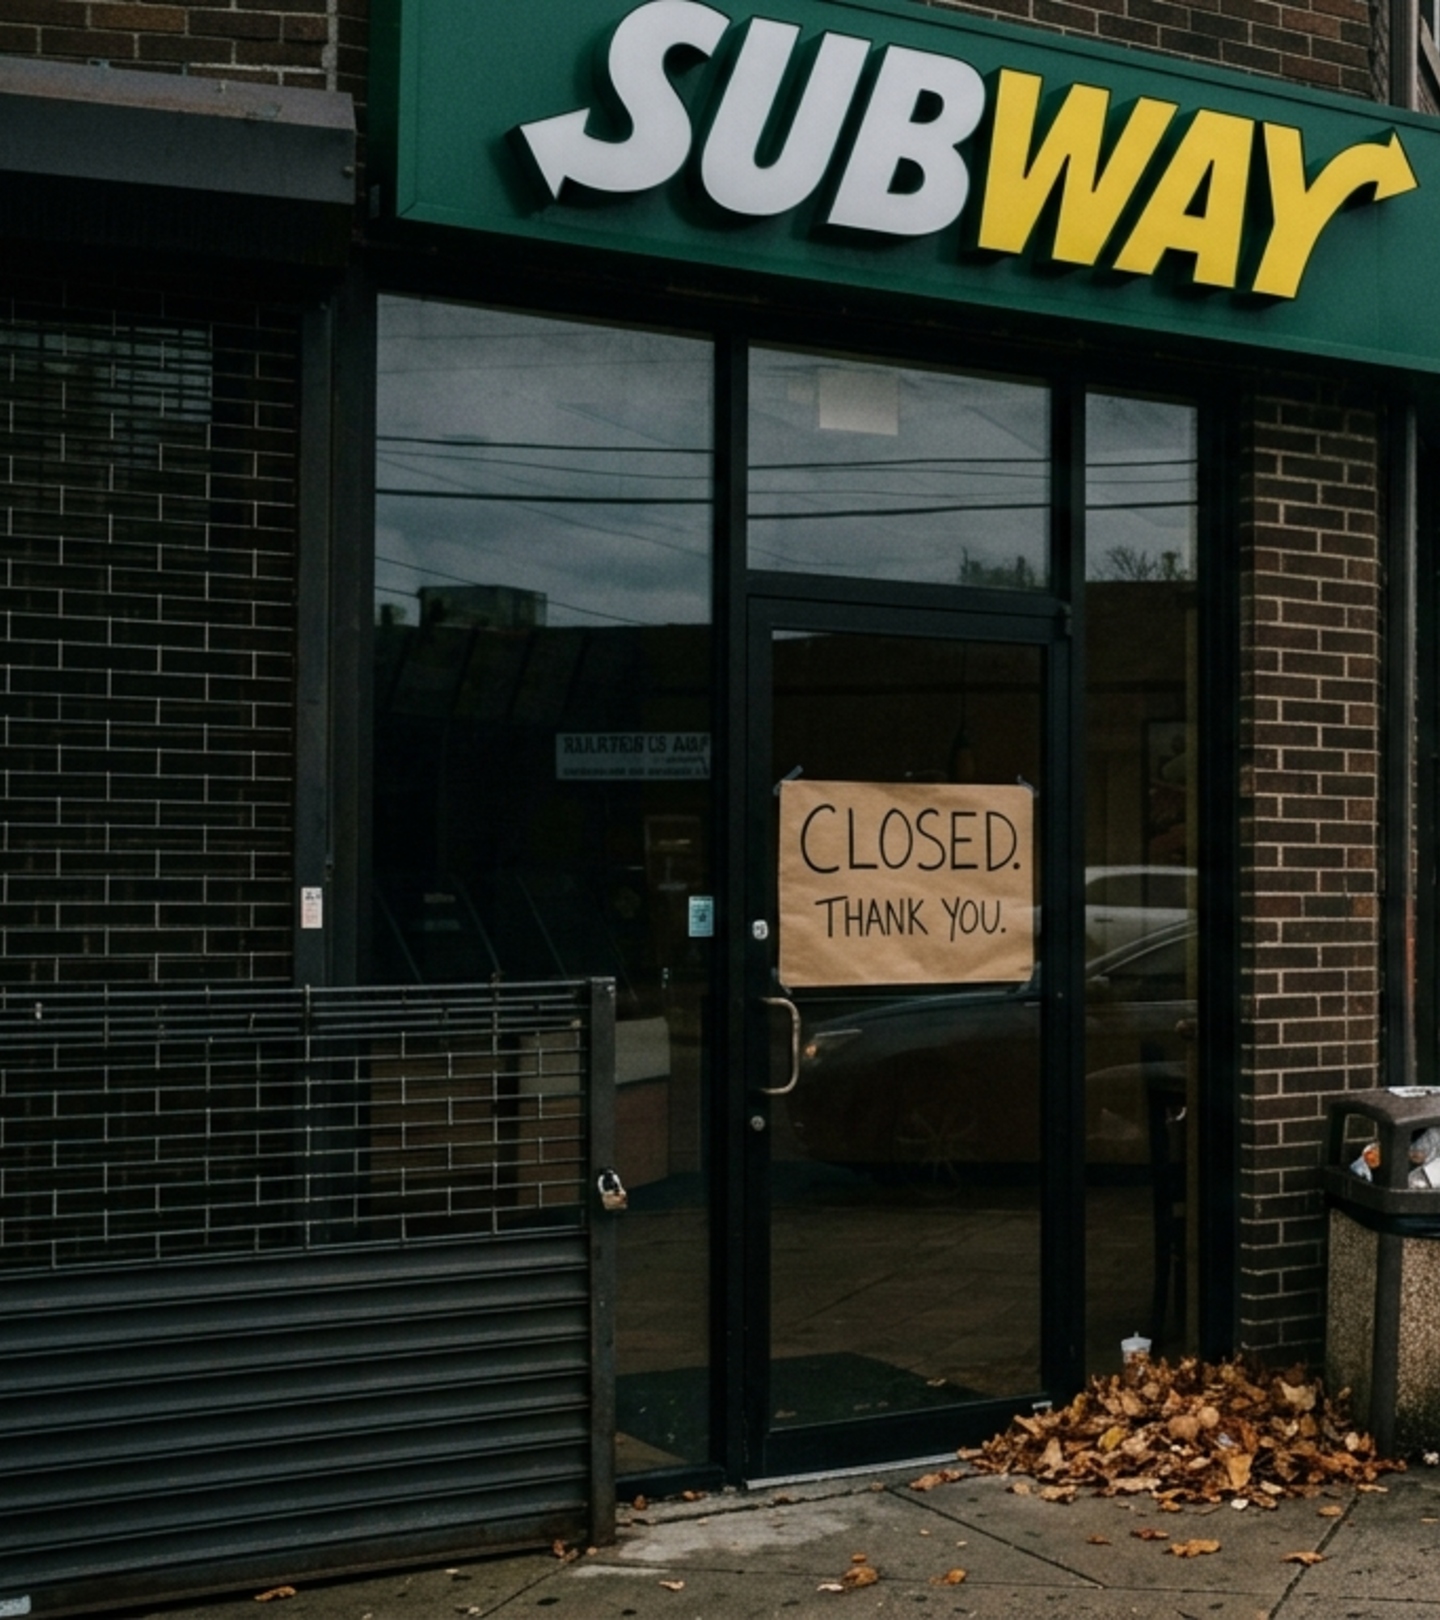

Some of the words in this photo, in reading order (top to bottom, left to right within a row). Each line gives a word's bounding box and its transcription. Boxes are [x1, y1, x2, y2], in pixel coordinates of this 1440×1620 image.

[519, 0, 1418, 298] SUBWAY
[800, 804, 1021, 874] CLOSED.
[815, 896, 928, 938] THANK
[941, 896, 1006, 942] YOU.
